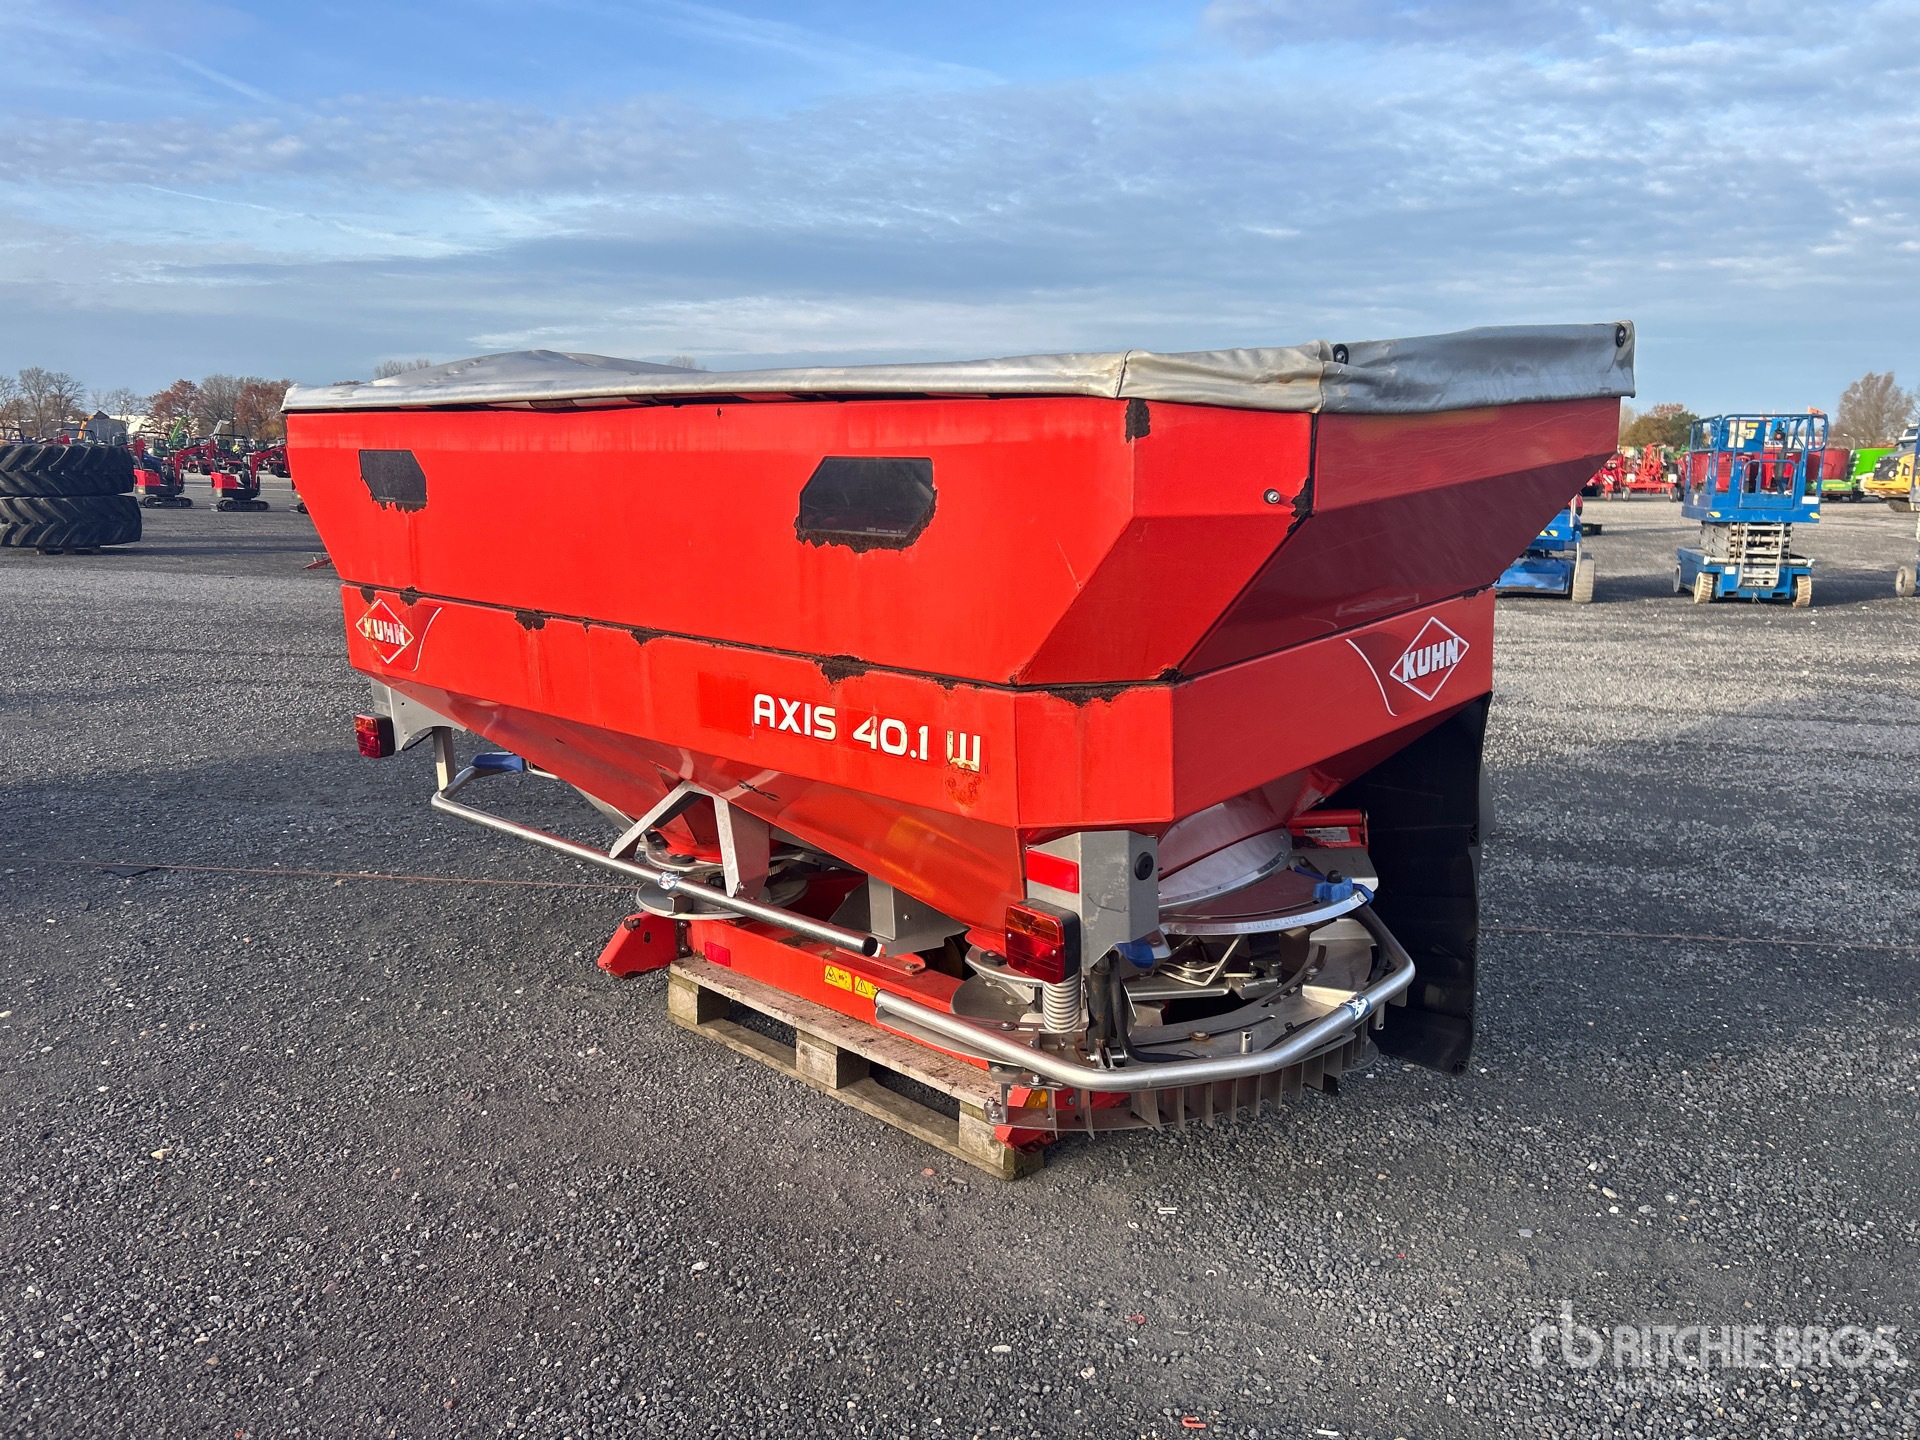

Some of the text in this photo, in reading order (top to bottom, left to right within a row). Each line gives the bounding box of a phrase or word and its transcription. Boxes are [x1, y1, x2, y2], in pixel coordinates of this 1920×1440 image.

[363, 617, 406, 647] KUHN
[1402, 636, 1459, 683] KUHN
[753, 693, 837, 741] AXIS
[851, 715, 930, 761] 40.1
